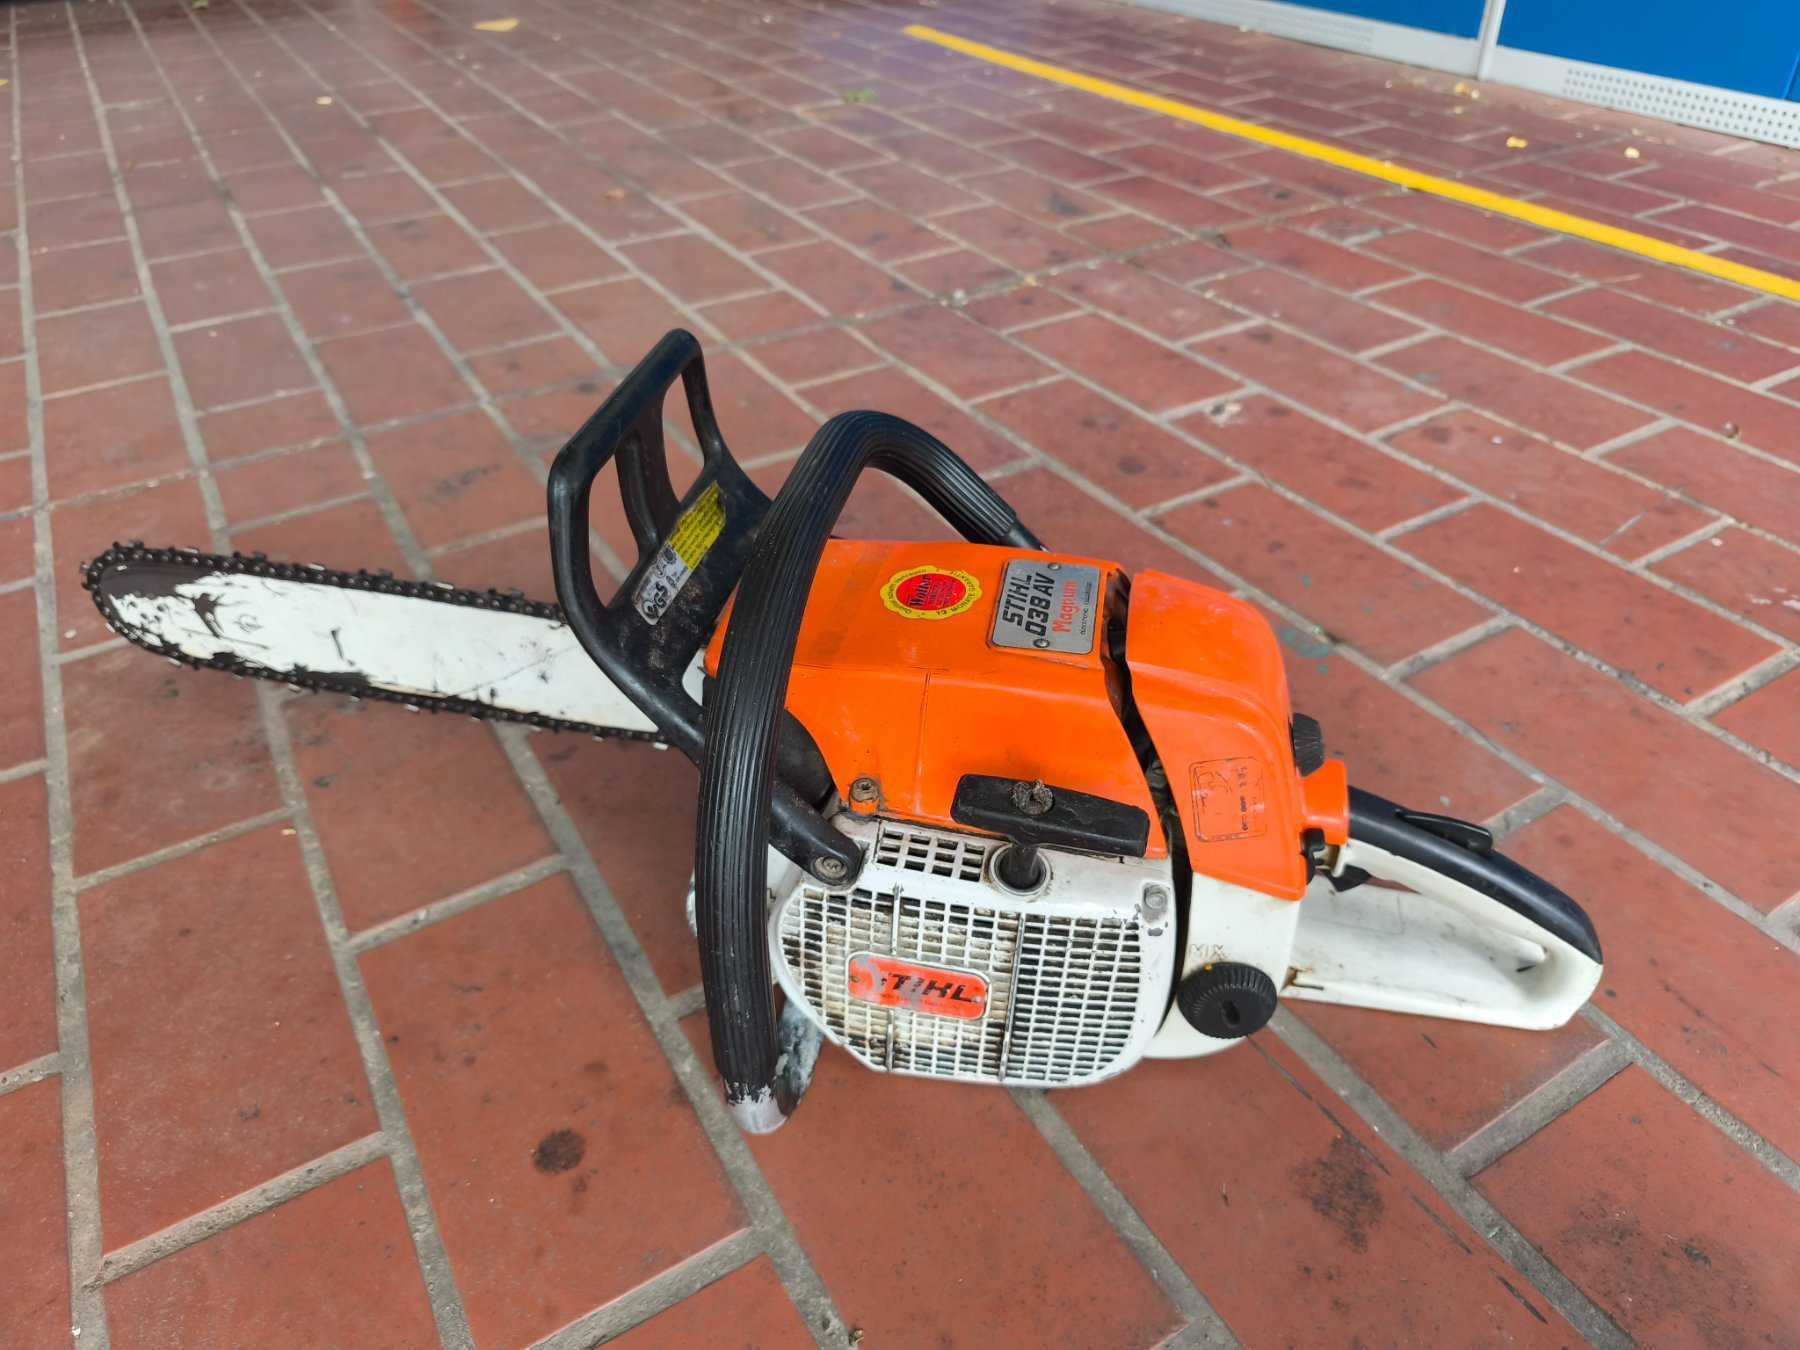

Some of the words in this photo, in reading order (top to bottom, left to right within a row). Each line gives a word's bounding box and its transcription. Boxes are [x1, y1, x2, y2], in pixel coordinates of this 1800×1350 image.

[1002, 575, 1033, 627] STIHL
[1033, 572, 1055, 597] AV
[1052, 580, 1080, 633] Magnum
[1025, 594, 1051, 637] 038
